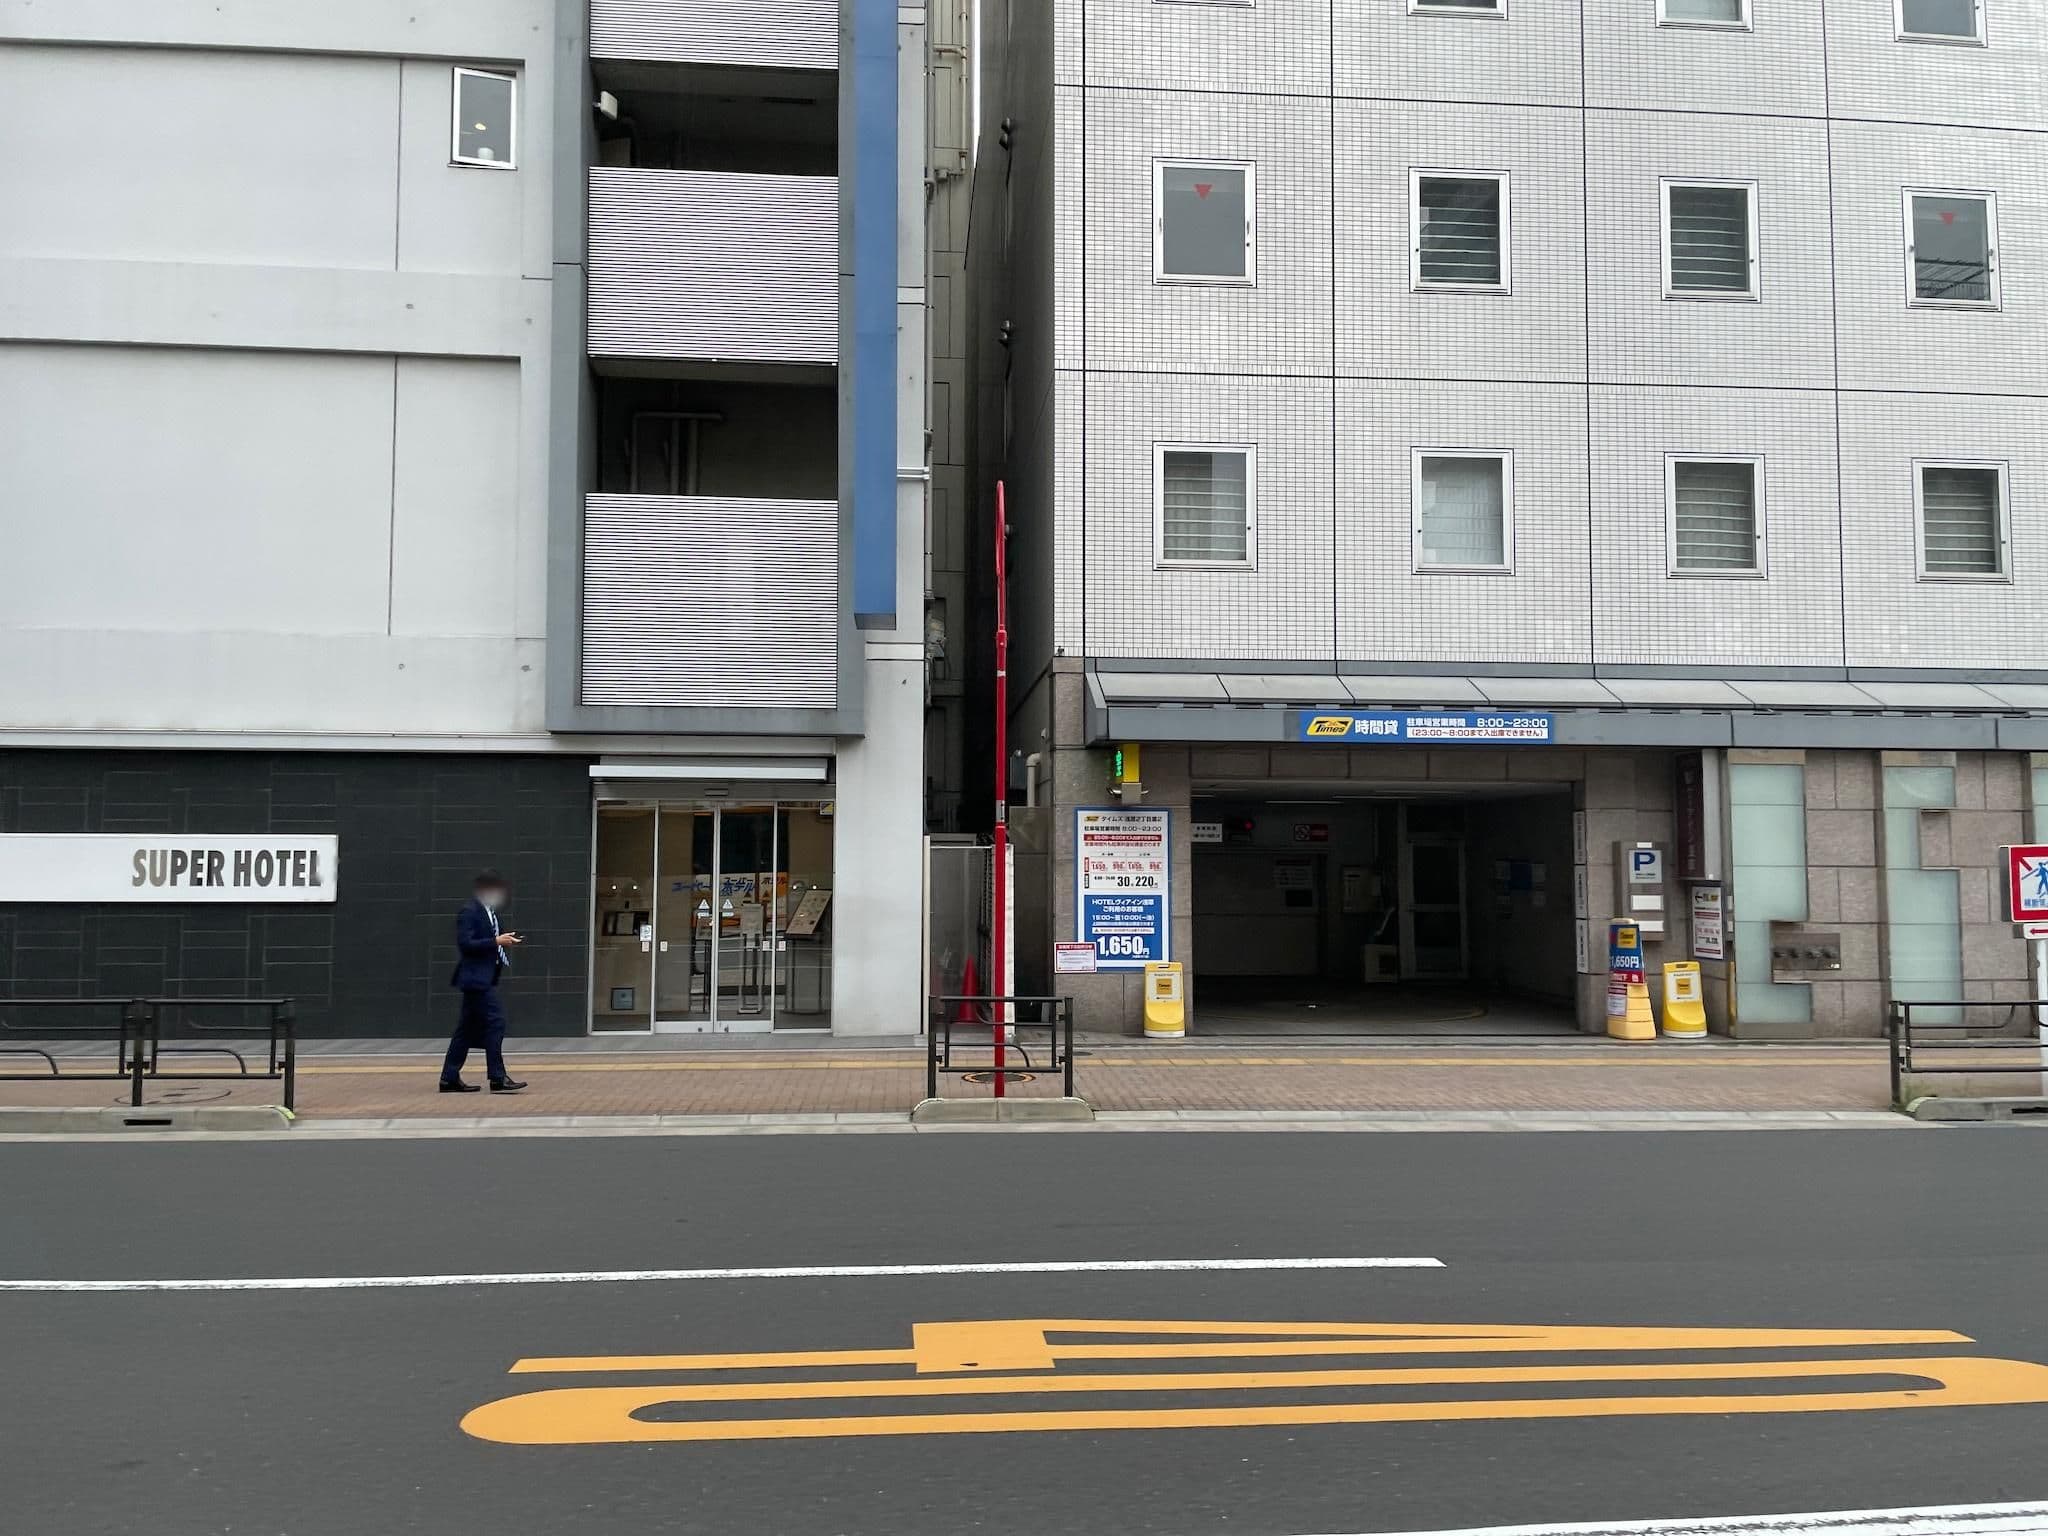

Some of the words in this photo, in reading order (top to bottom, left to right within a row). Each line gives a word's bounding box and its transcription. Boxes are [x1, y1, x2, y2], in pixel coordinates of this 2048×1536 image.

[1355, 719, 1399, 735] 時間貸
[132, 848, 225, 888] SUPER
[233, 849, 322, 888] HOTEL
[1634, 851, 1656, 871] P
[1097, 935, 1150, 957] 1,650円
